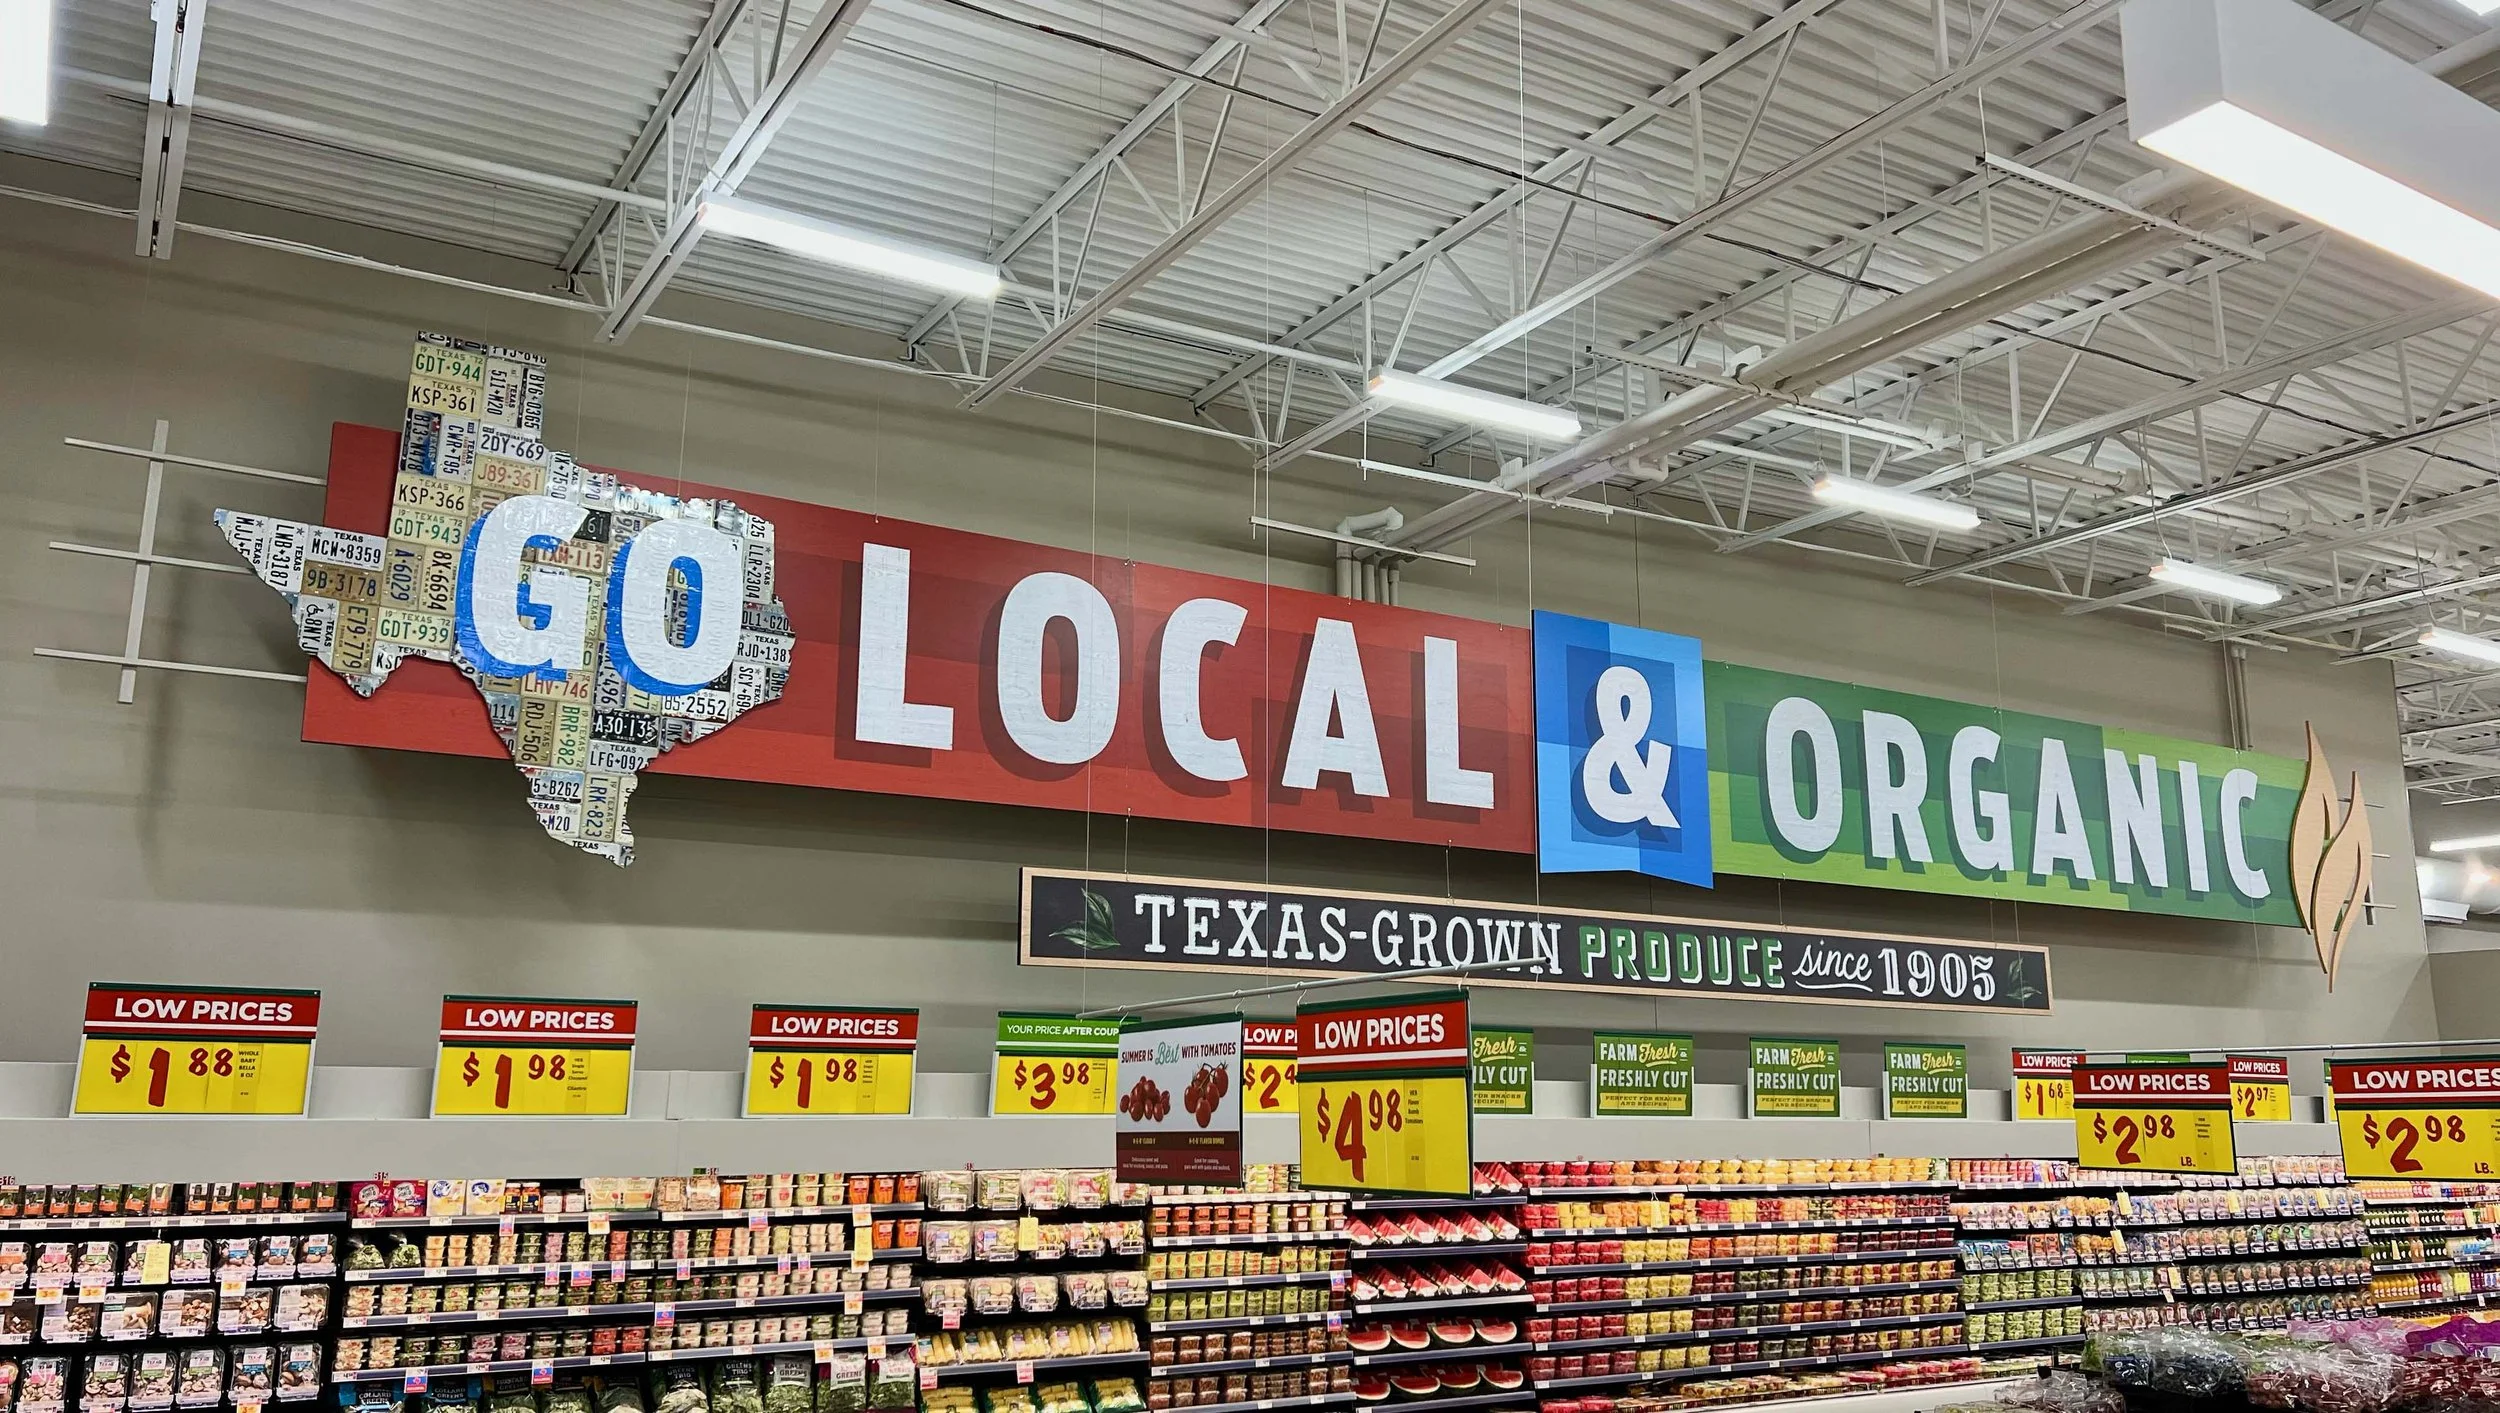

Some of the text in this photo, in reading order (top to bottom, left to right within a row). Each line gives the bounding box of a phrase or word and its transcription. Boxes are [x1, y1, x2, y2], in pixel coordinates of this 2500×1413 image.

[436, 348, 466, 361] TEXAS
[432, 380, 462, 393] TEXAS
[508, 384, 518, 409] TEXAS
[466, 440, 475, 465] TEXAS
[419, 478, 449, 490] TEXAS
[415, 512, 445, 524] TEXAS
[334, 531, 364, 543] TEXAS
[253, 538, 264, 565] TEXAS
[293, 545, 304, 572] TEXAS
[402, 612, 432, 625] TEXAS
[324, 620, 335, 647] TEXAS
[755, 635, 780, 645] TEXAS
[397, 646, 427, 657] TEXAS
[473, 495, 2273, 900] GO LOCAL & ORGANIC
[542, 720, 552, 747] TEXAS
[578, 724, 587, 752] TEXAS
[610, 744, 637, 754] TEXAS
[532, 801, 561, 811] TEXAS
[606, 796, 617, 824] TEXAS
[572, 840, 599, 850] TEXAS
[1134, 893, 1996, 1001] TEXAS-GROWN PRODUCE since 1905
[115, 998, 293, 1022] LOW PRICES
[465, 1008, 615, 1030] LOW PRICES
[771, 1016, 899, 1035] LOW PRICES
[1007, 1025, 1033, 1034] YOUR
[1035, 1026, 1061, 1035] PRICE
[1062, 1027, 1092, 1035] AFTER
[1314, 1013, 1445, 1050] LOW PRICES
[1244, 1028, 1282, 1043] LOW
[1121, 1041, 1237, 1065] SUMMER IS Best WITH TOMATOES
[1473, 1036, 1517, 1058] Fresh
[1600, 1042, 1678, 1063] FARM Fresh
[1756, 1047, 1826, 1067] FARM Fresh
[1890, 1052, 1954, 1071] FARM Fresh
[2021, 1055, 2078, 1068] LOW PRICES
[1500, 1066, 1528, 1085] CUT
[2233, 1061, 2280, 1073] LOW PRICES
[1600, 1069, 1688, 1088] FRESHLY CUT
[1757, 1072, 1835, 1090] FRESHLY CUT
[1892, 1076, 1963, 1093] FRESHLY CUT
[2089, 1074, 2211, 1091] LOW PRICES
[2353, 1067, 2500, 1089] LOW PRICES
[2181, 1157, 2196, 1167] LB.
[2474, 1162, 2494, 1174] LB.
